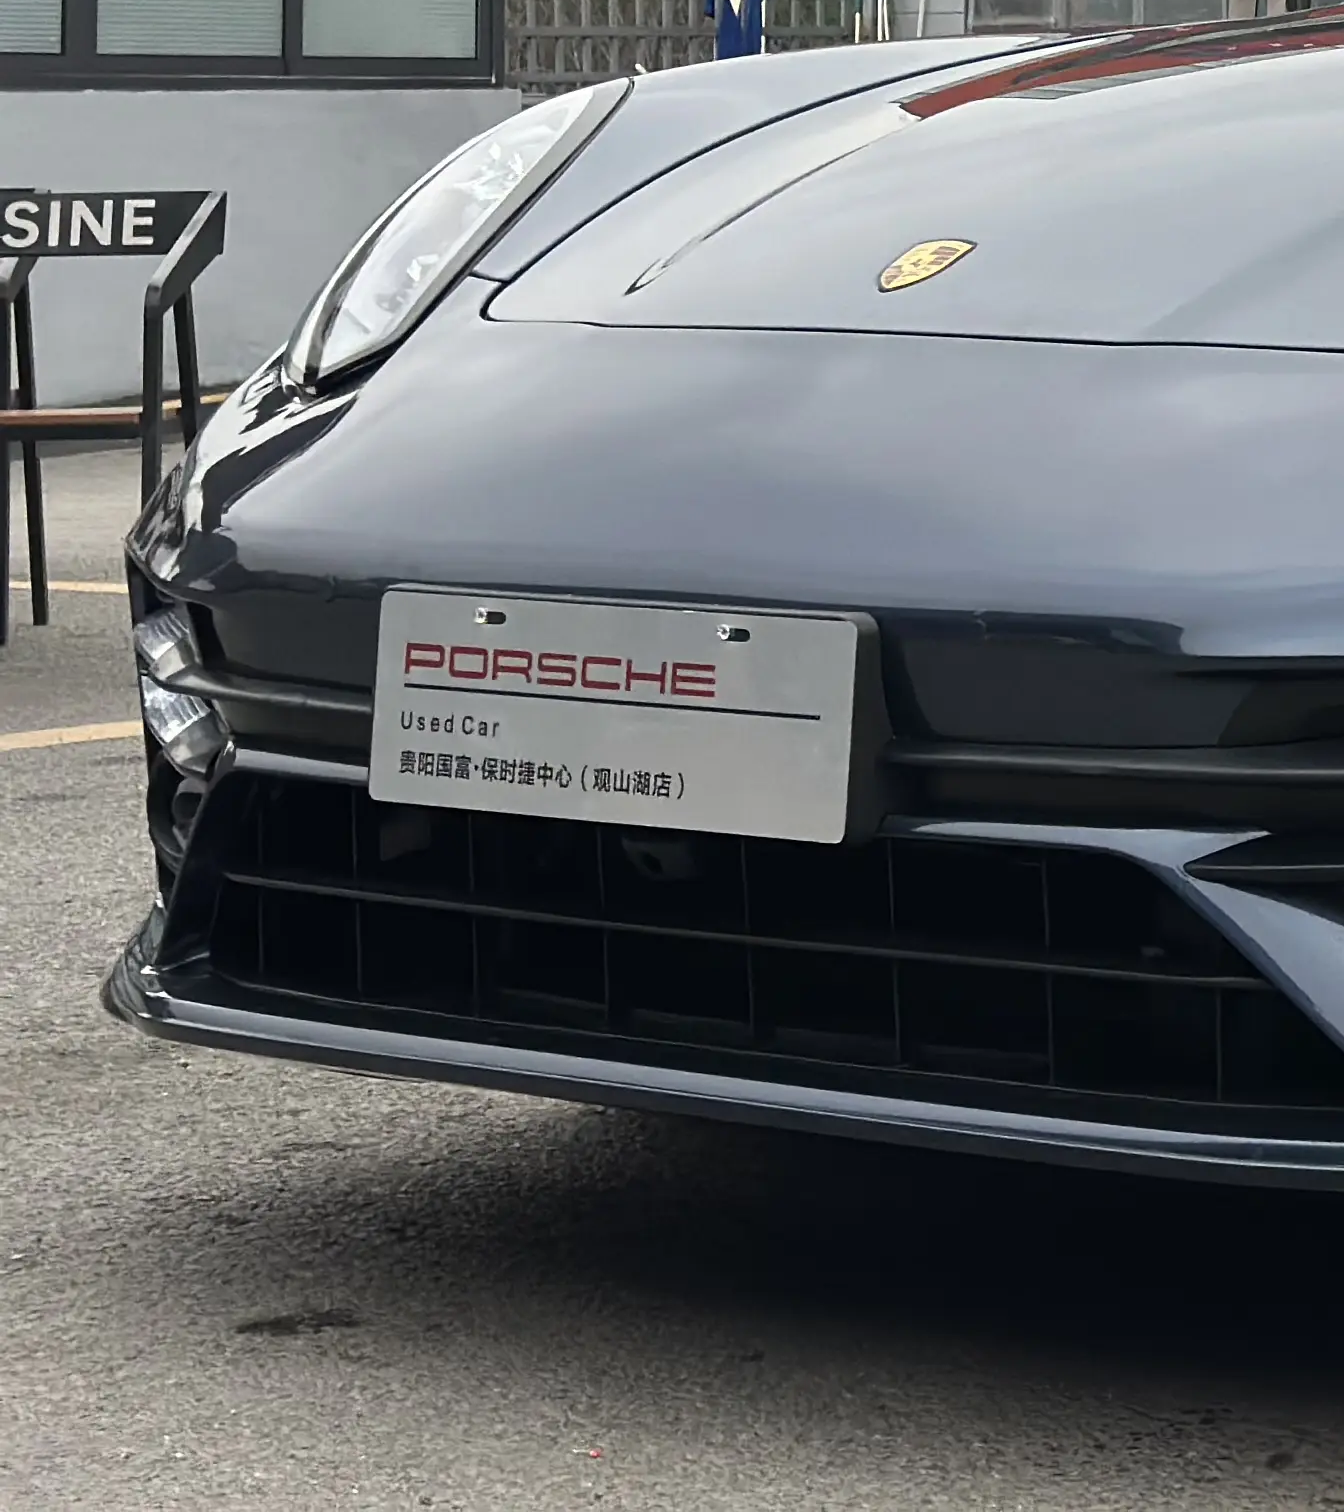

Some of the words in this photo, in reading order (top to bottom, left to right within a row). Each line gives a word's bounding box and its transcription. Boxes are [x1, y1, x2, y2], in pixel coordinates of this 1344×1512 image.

[0, 199, 156, 248] SINE
[404, 642, 717, 698] PORSCHE
[400, 710, 455, 734] Used
[461, 715, 500, 738] Car
